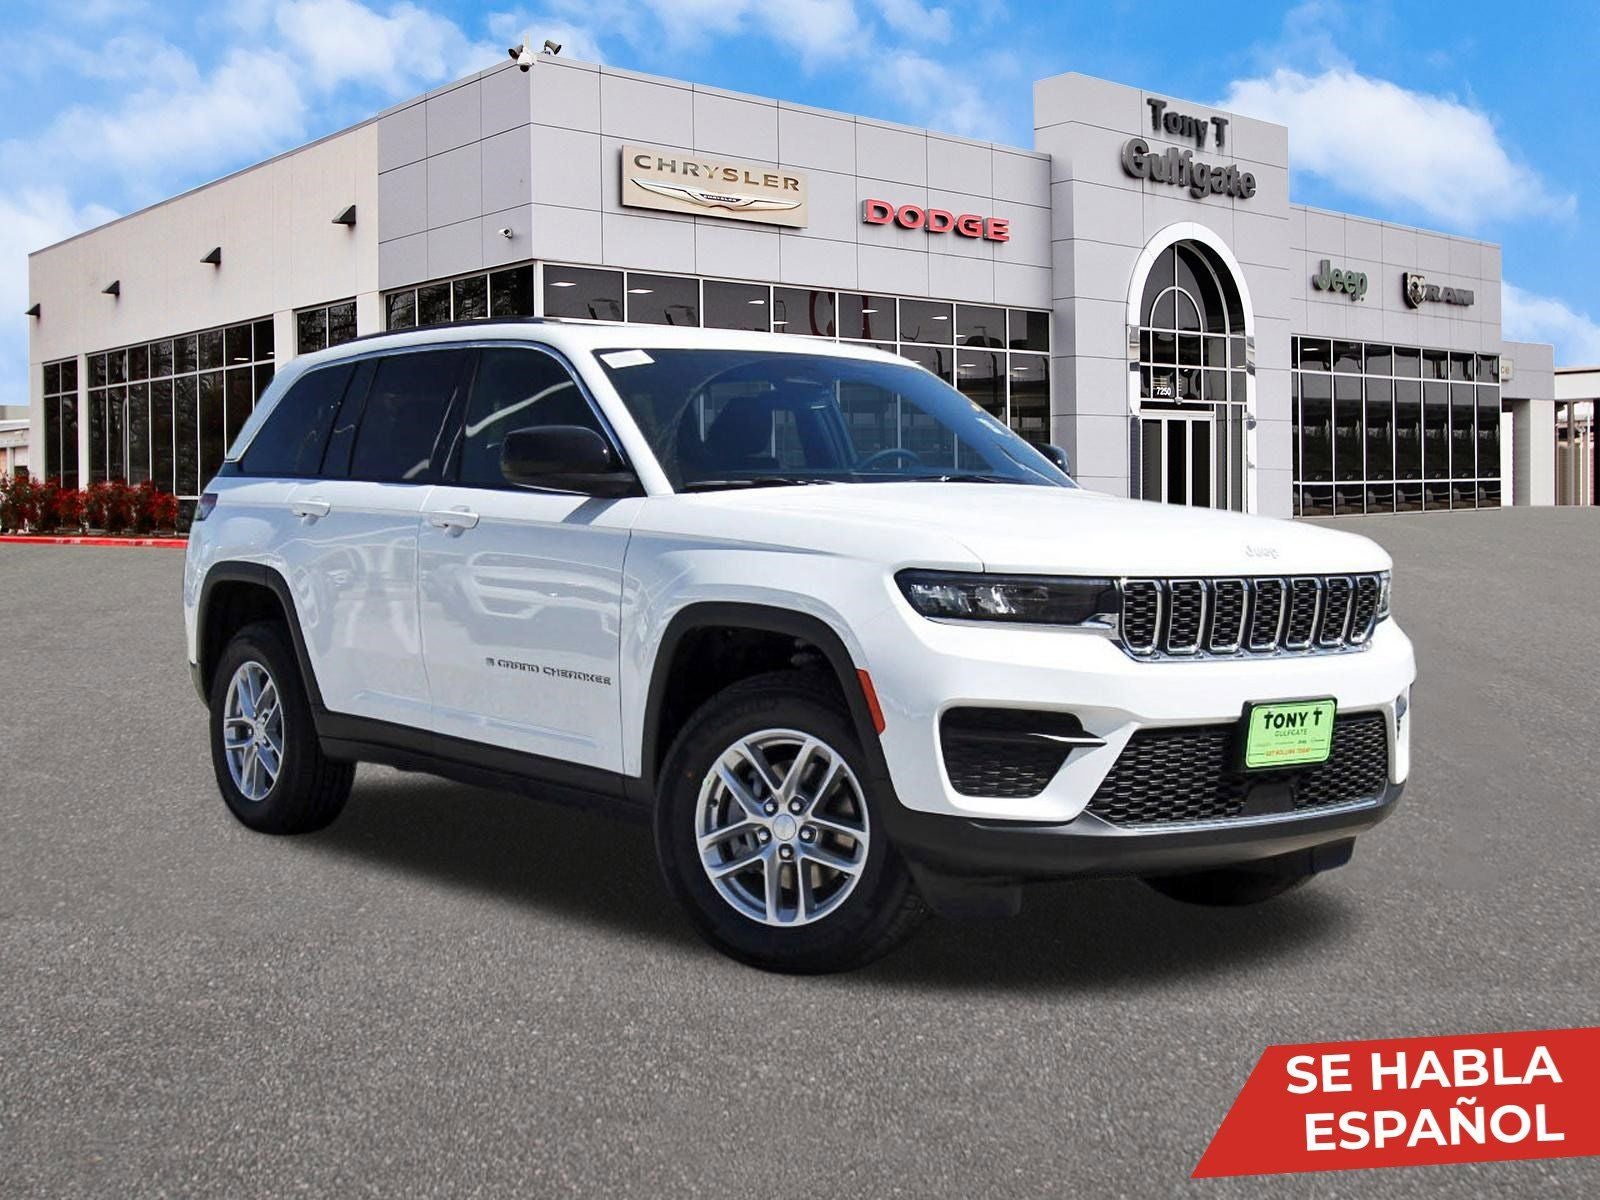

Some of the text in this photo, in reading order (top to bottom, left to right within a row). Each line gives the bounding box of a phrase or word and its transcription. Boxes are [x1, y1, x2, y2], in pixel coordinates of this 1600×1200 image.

[1147, 98, 1229, 148] Tony T
[633, 154, 800, 192] CHRYSLER
[1121, 138, 1256, 199] Gulfgate
[862, 198, 1010, 243] DODGE
[1312, 259, 1368, 301] Jeep
[1425, 284, 1474, 307] RAM
[1156, 387, 1172, 396] 7250
[497, 658, 612, 686] GRAND CHEROKEE
[1264, 706, 1323, 730] TONY T
[1274, 729, 1308, 737] GULFGATE
